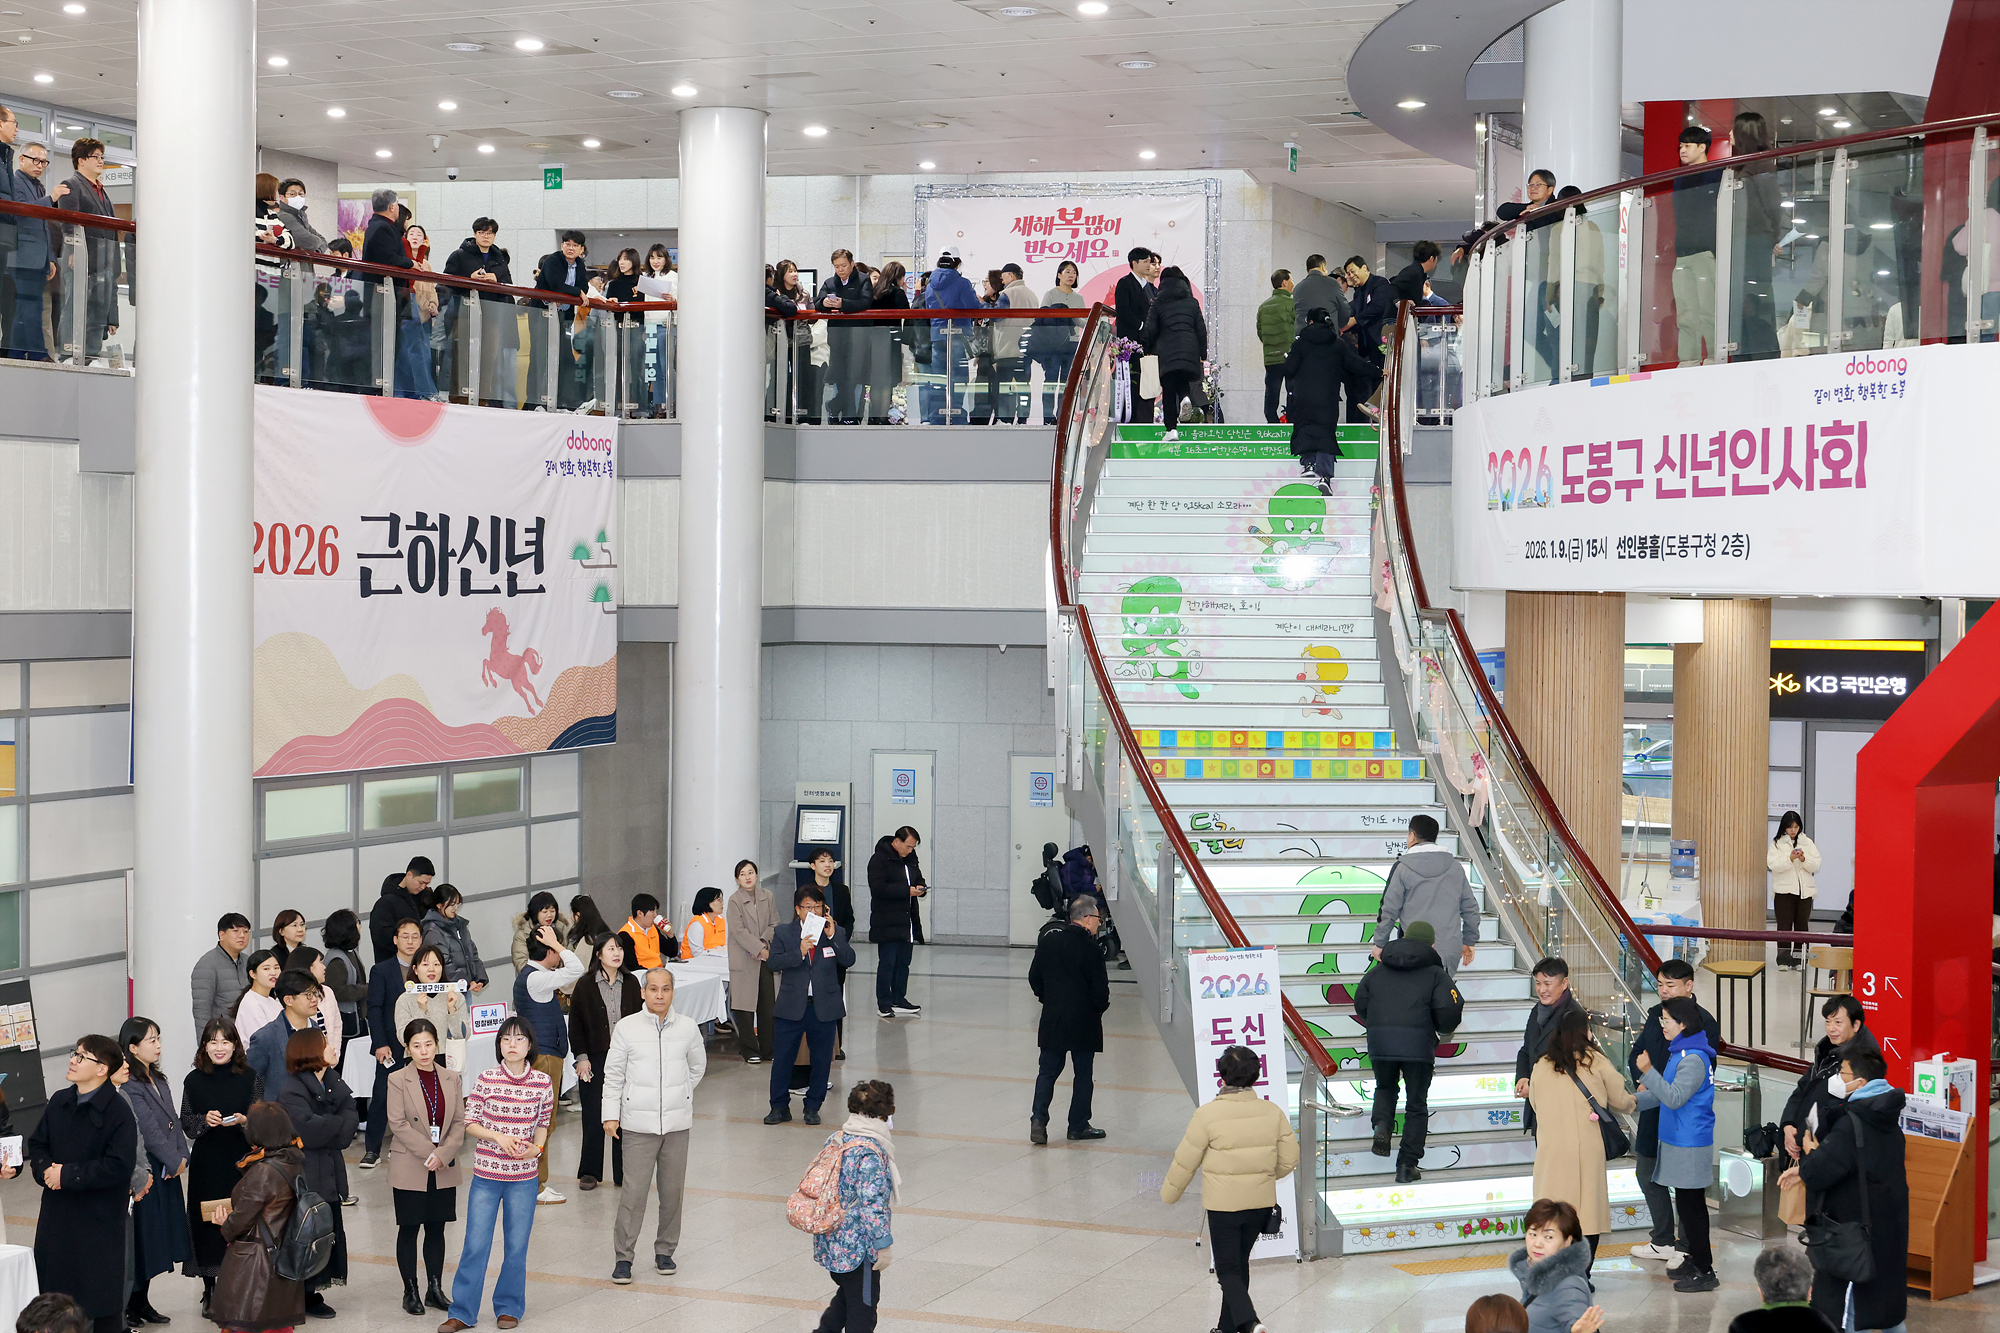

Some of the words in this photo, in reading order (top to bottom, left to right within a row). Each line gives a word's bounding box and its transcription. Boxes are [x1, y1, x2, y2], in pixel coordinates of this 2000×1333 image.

[1024, 238, 1109, 264] 받으세요
[1845, 354, 1908, 376] dobong
[1813, 389, 1831, 405] 같이
[1858, 381, 1888, 401] 행복한
[1890, 379, 1906, 399] 도봉
[566, 429, 612, 457] dobong
[1226, 429, 1252, 440] 당신은
[577, 458, 602, 478] 행복한
[1487, 445, 1554, 512] 2026
[1561, 438, 1644, 504] 도봉구
[1653, 419, 1868, 500] 신년인사회
[1128, 501, 1144, 511] 계단
[253, 521, 340, 577] 2026
[356, 511, 547, 599] 근하신년
[1586, 536, 1608, 560] 15시
[1721, 532, 1751, 561] 2층)
[1274, 622, 1301, 633] 계단이
[1361, 814, 1389, 827] 전기도
[1199, 972, 1272, 999] 2026
[1862, 971, 1876, 997] 3
[1475, 1076, 1509, 1092] 계단을
[1487, 1110, 1521, 1125] 건강도
